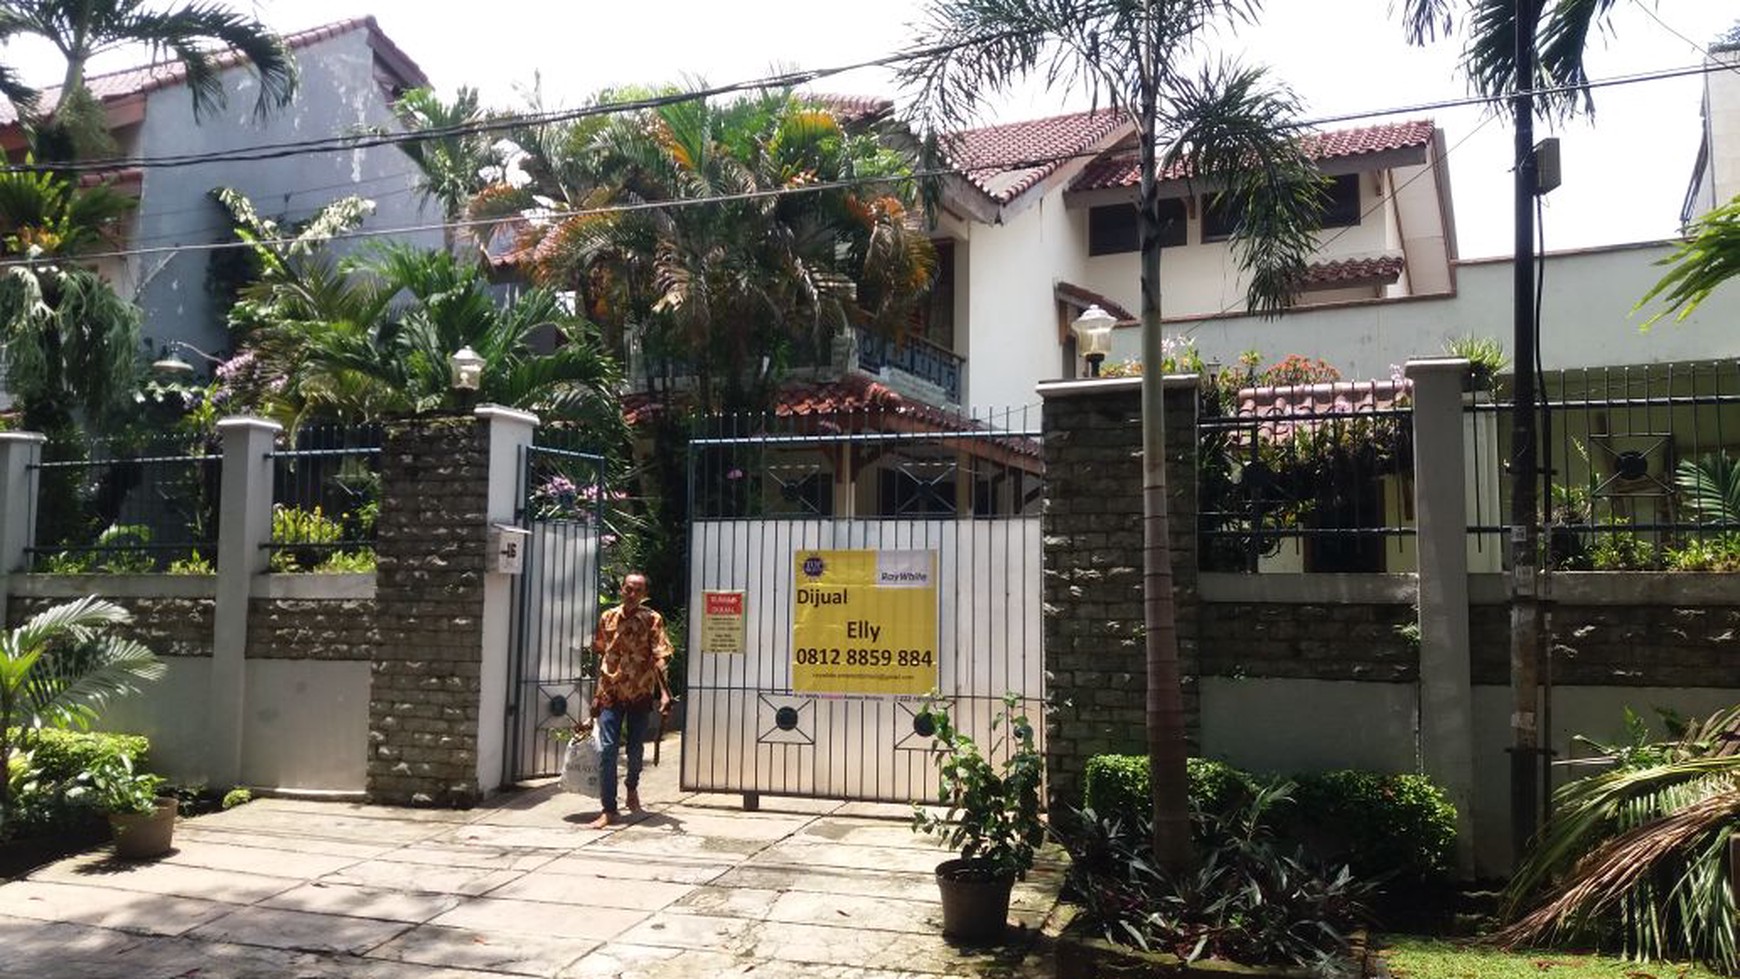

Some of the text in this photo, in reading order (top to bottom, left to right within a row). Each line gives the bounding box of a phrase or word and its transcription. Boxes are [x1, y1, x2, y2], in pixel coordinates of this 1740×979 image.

[797, 589, 848, 607] Dijual
[847, 620, 881, 643] Elly
[796, 648, 933, 667] 0812 8859 884
